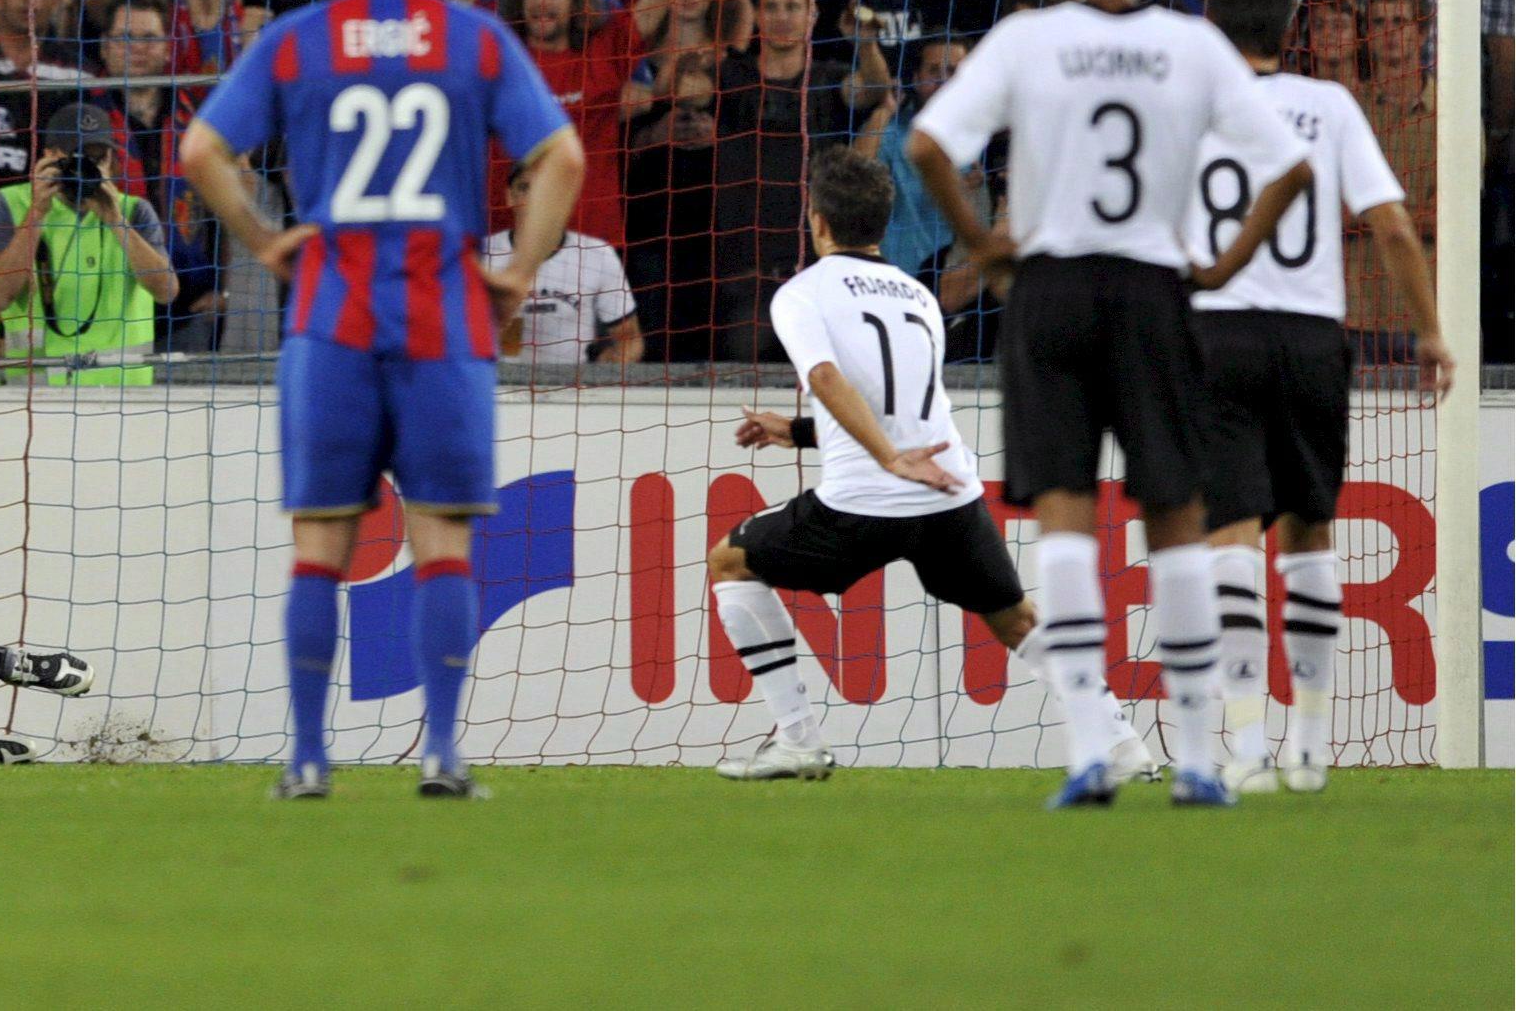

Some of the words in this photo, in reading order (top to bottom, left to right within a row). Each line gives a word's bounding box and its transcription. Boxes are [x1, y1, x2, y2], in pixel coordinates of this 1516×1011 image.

[329, 82, 450, 223] 22
[1090, 101, 1143, 224] 3
[842, 274, 928, 309] FAJARDO
[860, 310, 937, 422] 17
